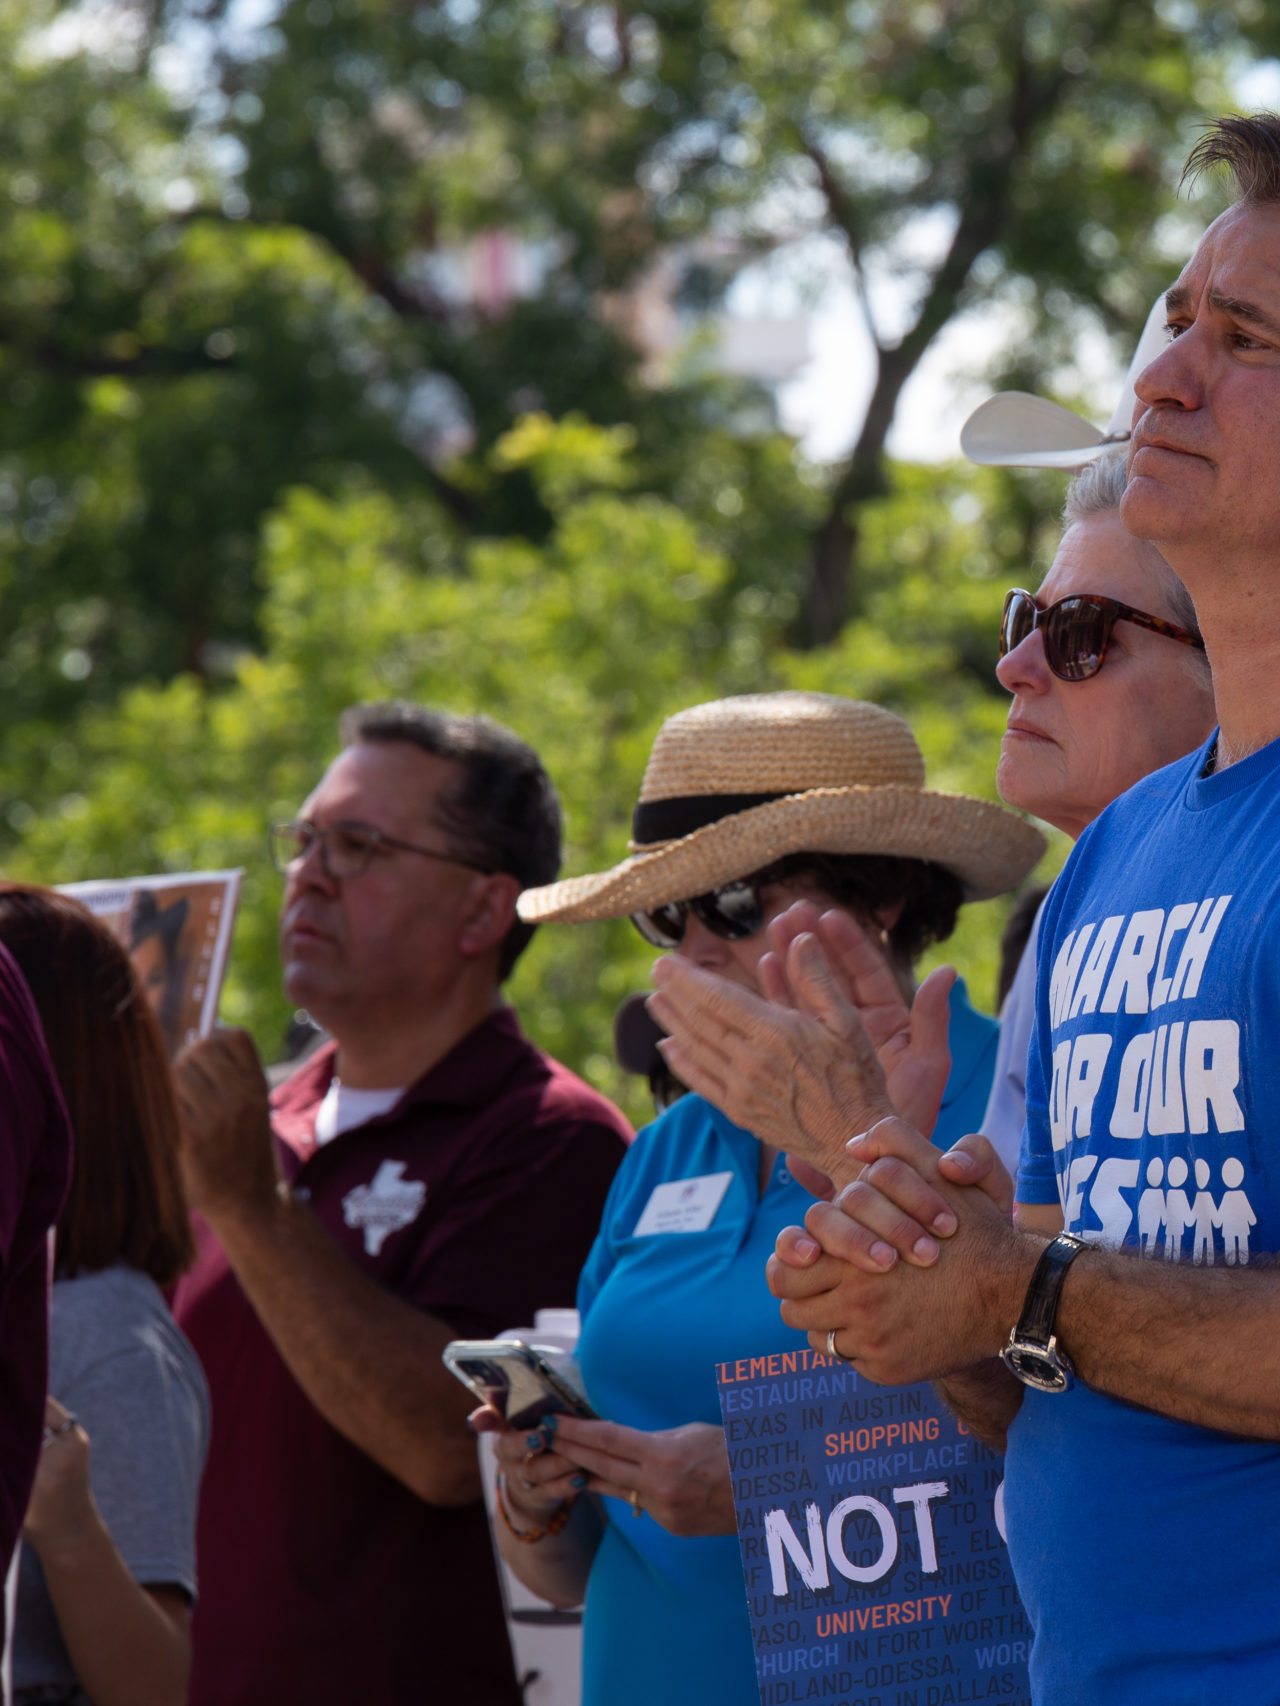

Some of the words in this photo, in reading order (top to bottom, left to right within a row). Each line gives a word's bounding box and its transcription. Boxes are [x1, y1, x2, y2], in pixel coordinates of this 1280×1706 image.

[1049, 895, 1232, 1032] MARCH
[1109, 1019, 1245, 1140] OUR
[715, 1348, 843, 1385] LEMENTA
[723, 1411, 788, 1443] EXAS
[801, 1405, 824, 1431] IN
[838, 1390, 928, 1425] AUSTIN,
[824, 1417, 940, 1457] SHOPPING
[733, 1468, 819, 1501] DESSA,
[825, 1443, 968, 1487] WORKPLACE
[764, 1481, 950, 1596] NOT
[952, 1501, 977, 1527] TO
[752, 1579, 892, 1618] UTHERLAND
[816, 1593, 952, 1638] UNIVERSITY
[960, 1588, 989, 1613] OF
[756, 1641, 840, 1678] HURCH
[847, 1637, 869, 1663] IN
[877, 1626, 935, 1658] FORT
[942, 1611, 1031, 1646] WORTH,
[926, 1671, 1021, 1706] DALLAS,
